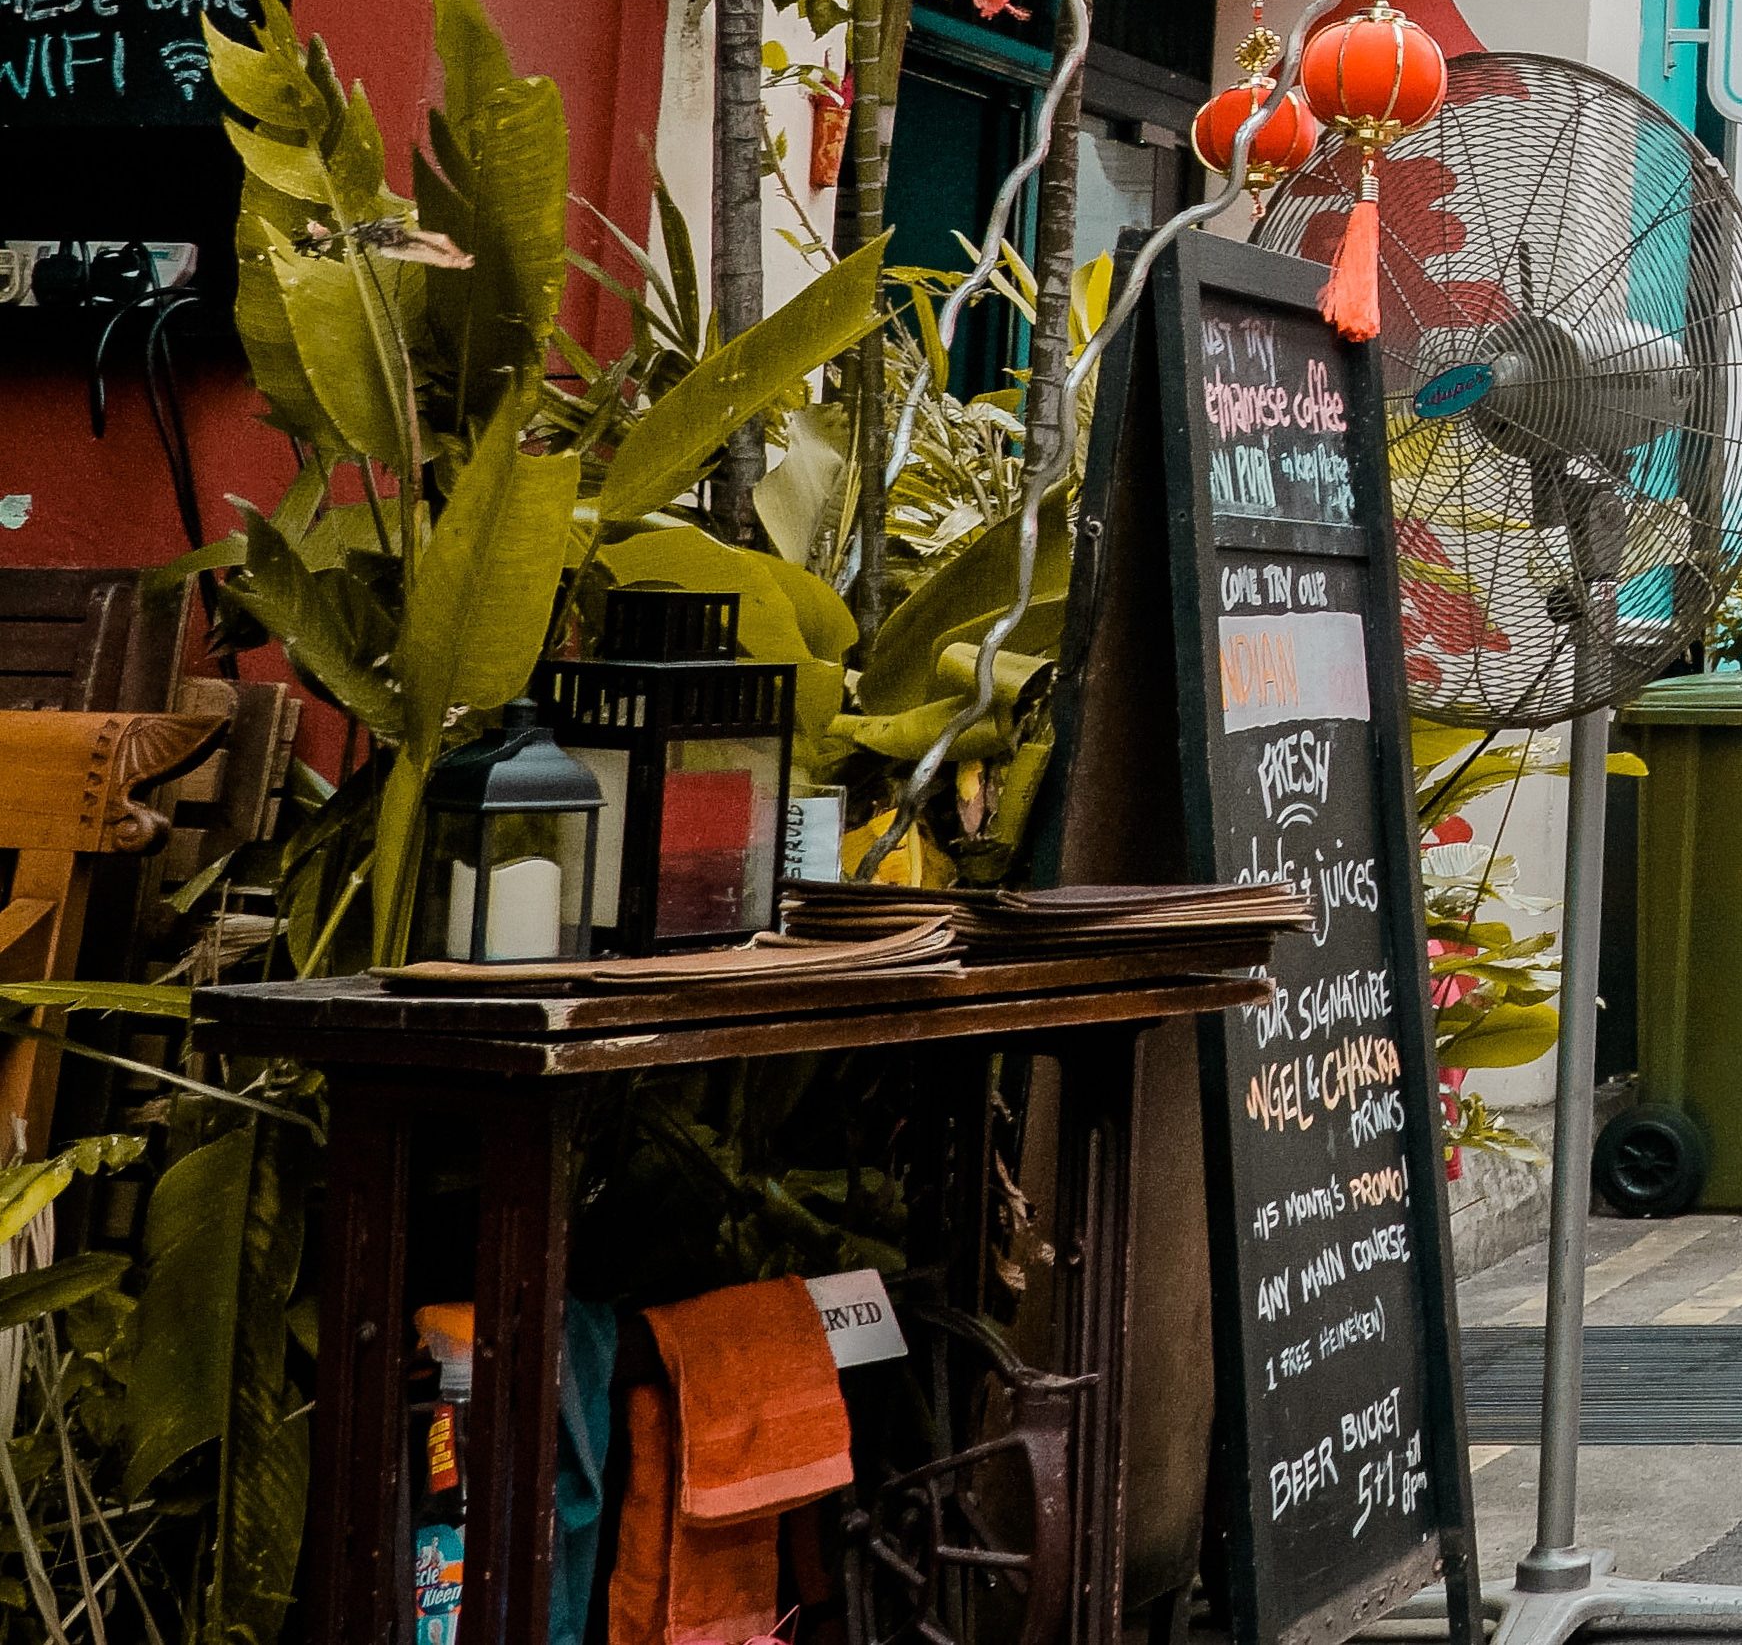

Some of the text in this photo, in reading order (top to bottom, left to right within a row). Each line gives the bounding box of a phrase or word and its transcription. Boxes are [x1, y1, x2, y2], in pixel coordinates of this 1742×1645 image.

[1221, 562, 1329, 611] COME TRY OUR
[1257, 729, 1331, 820] FRESH
[1311, 838, 1379, 948] juices
[1297, 967, 1393, 1042] SIGNATURE
[1305, 1054, 1321, 1101] &
[1320, 1034, 1401, 1111] CHAKRA
[1256, 1223, 1412, 1323] ANY MAIN COURSE
[820, 1300, 883, 1333] RVED
[1279, 1337, 1313, 1379] FREE
[1269, 1386, 1401, 1522] BEER BUCKET
